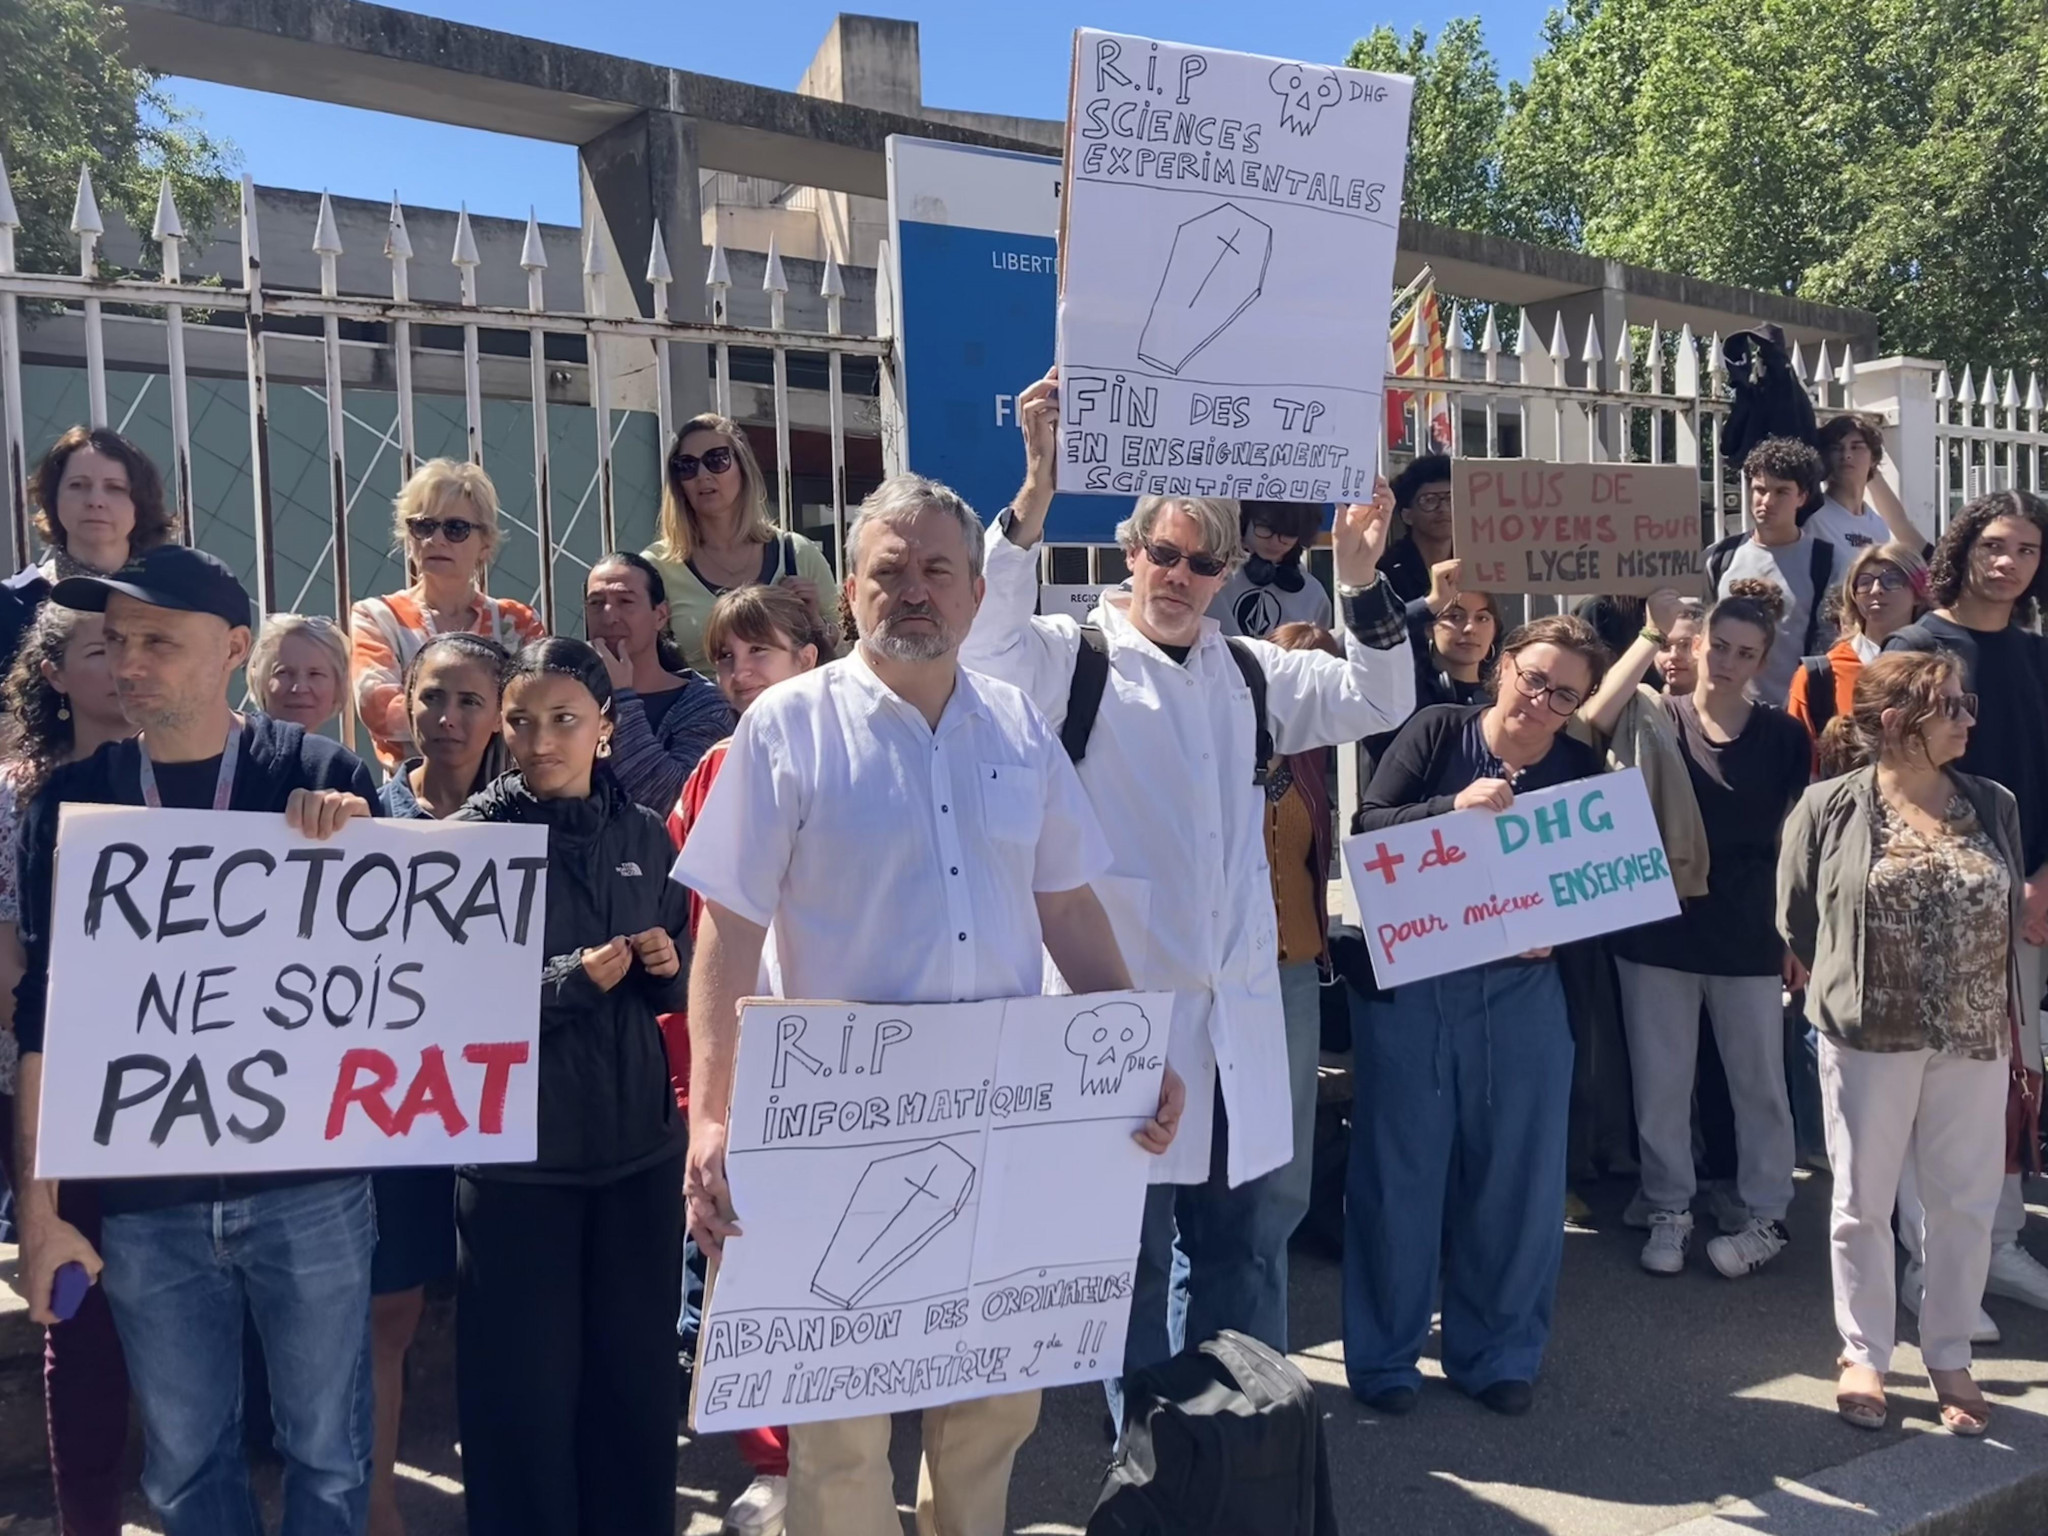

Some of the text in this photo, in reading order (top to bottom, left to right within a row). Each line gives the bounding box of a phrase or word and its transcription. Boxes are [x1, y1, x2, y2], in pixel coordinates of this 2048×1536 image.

[1349, 80, 1389, 102] DHG
[1190, 393, 1250, 428] DES
[1273, 398, 1326, 433] TP
[1065, 431, 1108, 464] EN
[1467, 471, 1634, 509] PLUS DE
[1470, 514, 1617, 544] MOYENS
[1476, 561, 1507, 583] LE
[1526, 543, 1600, 582] LYCÉE
[1070, 593, 1100, 603] REGIO
[1417, 828, 1467, 873] de
[1495, 789, 1615, 855] DHG
[83, 841, 548, 946] RECTORAT
[1463, 891, 1544, 926] mieux
[1549, 846, 1669, 907] ENSEIGNER
[135, 964, 238, 1035] NE
[1127, 1055, 1163, 1073] DHG
[92, 1040, 530, 1148] PAS RAT
[703, 1309, 902, 1366] ABANDON
[924, 1299, 969, 1335] DES
[704, 1369, 771, 1415] EN
[1073, 1320, 1107, 1370] !!
